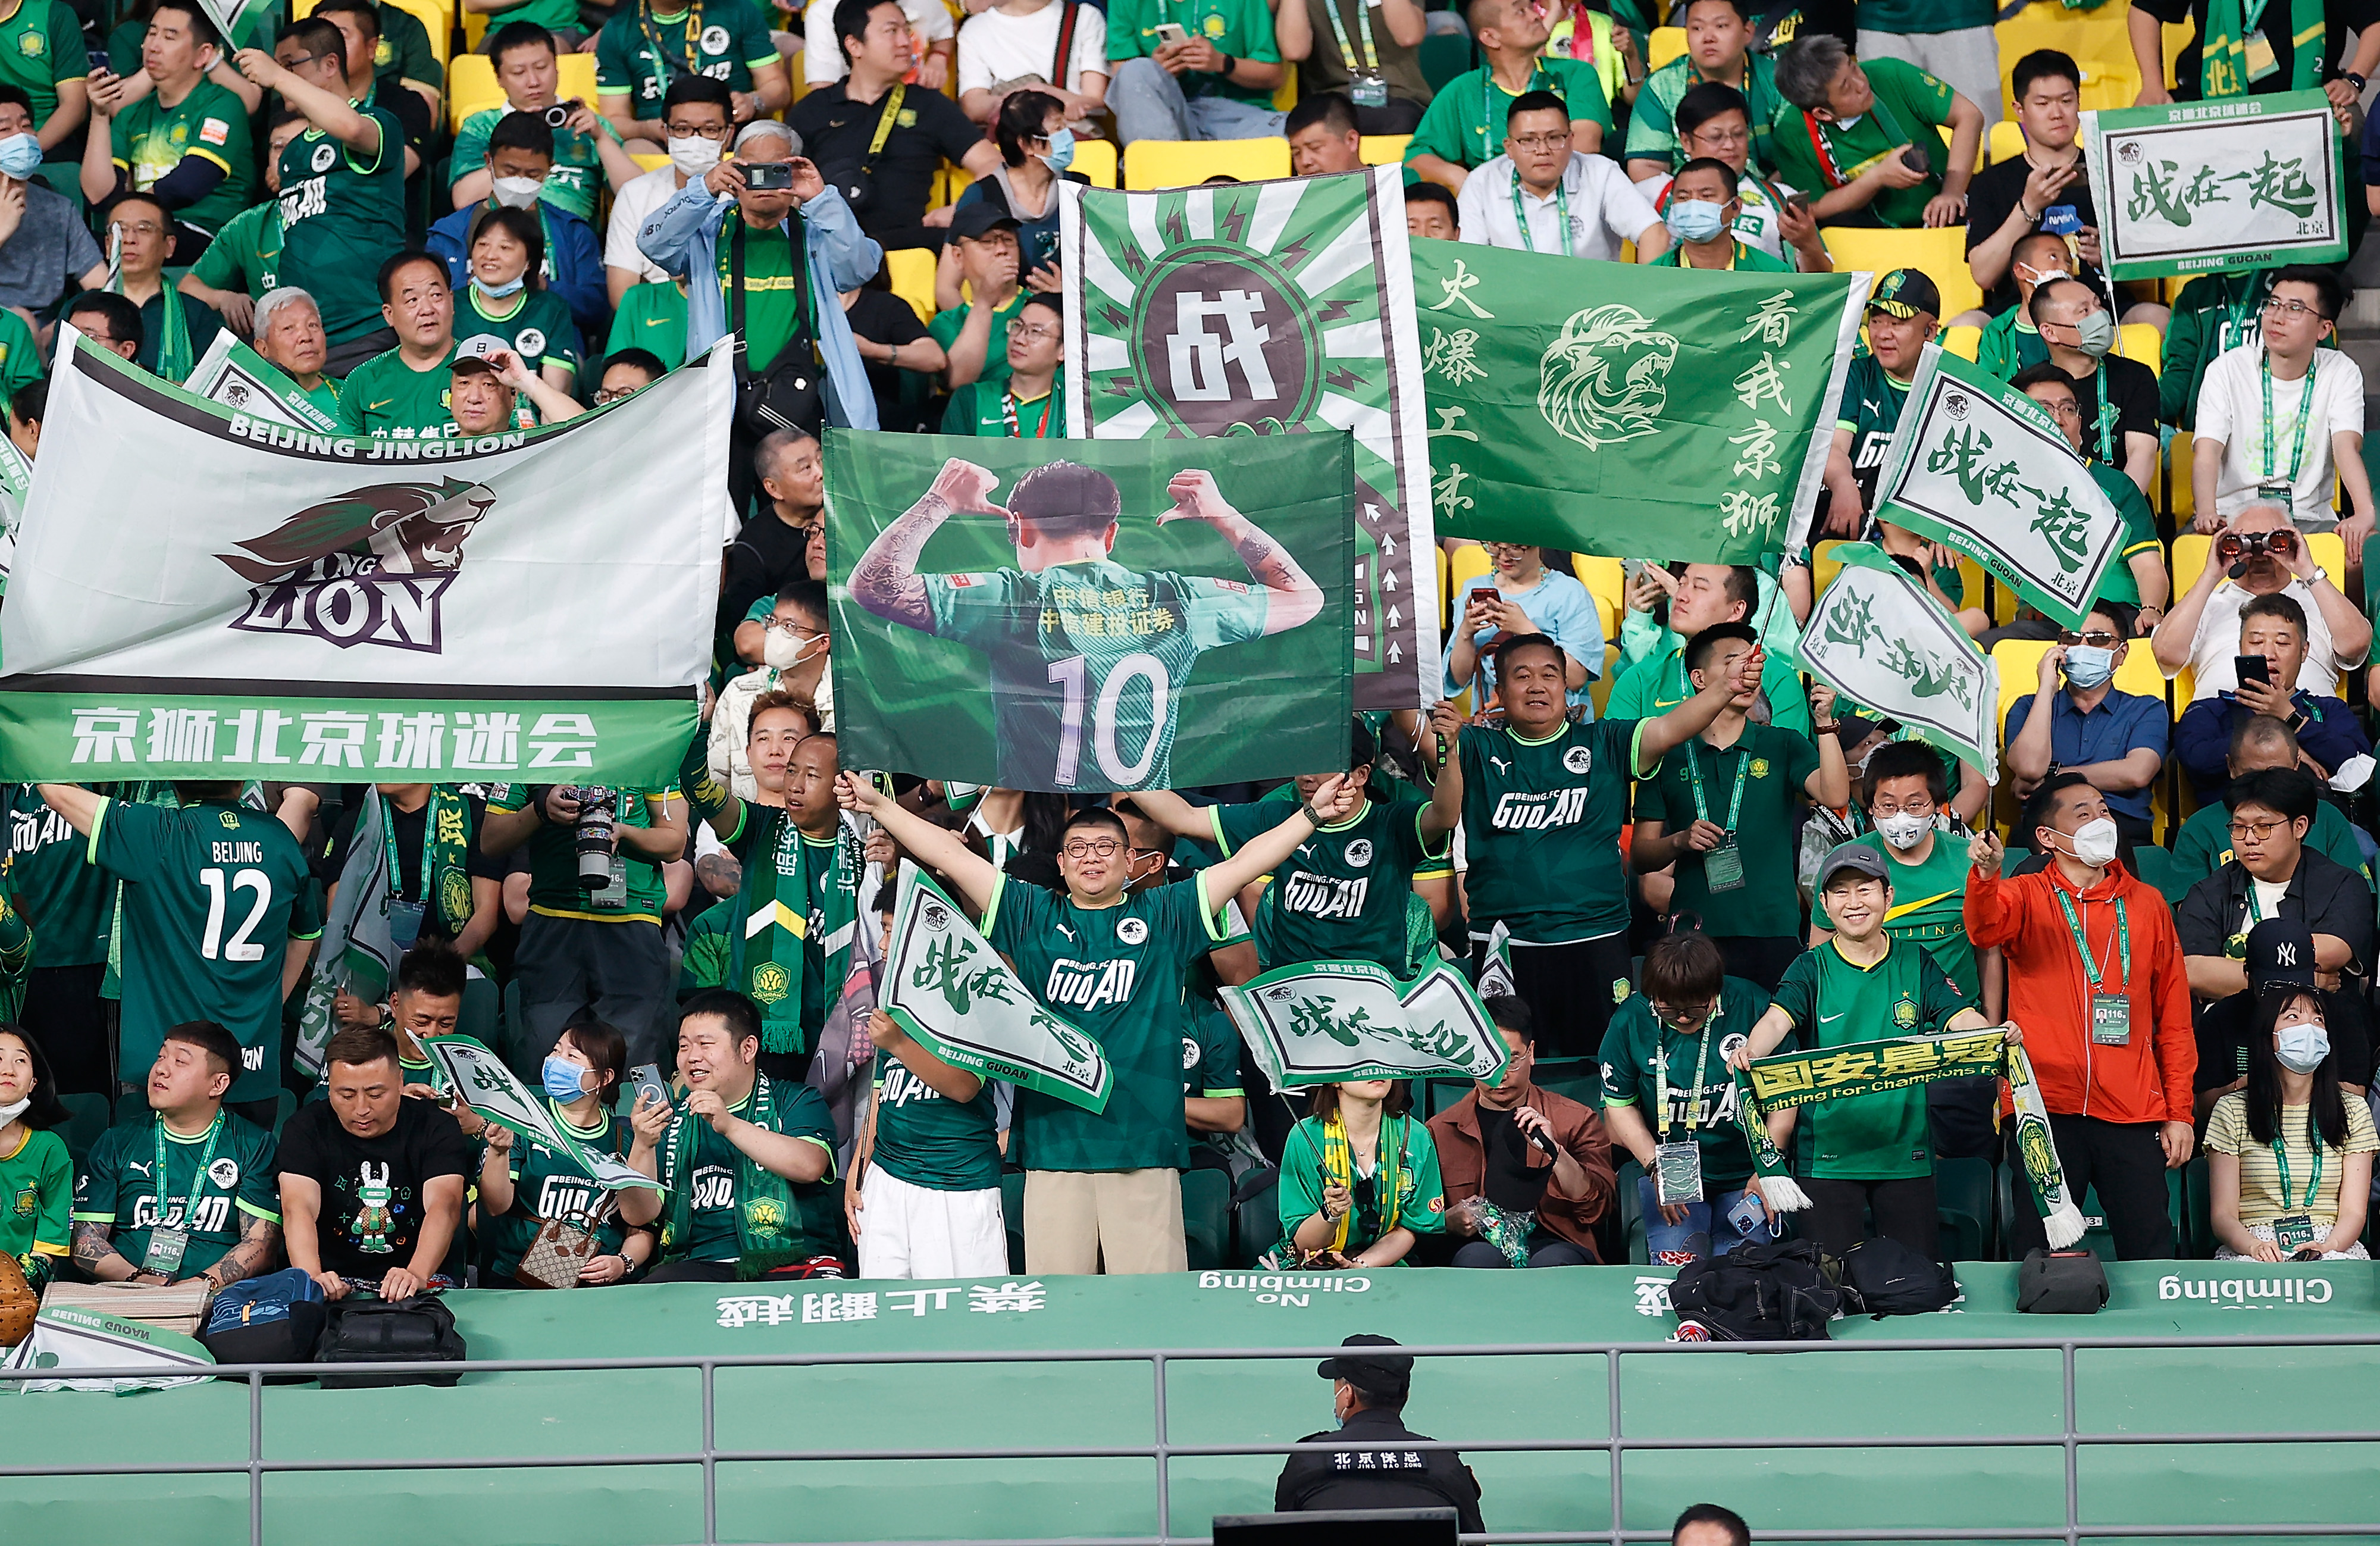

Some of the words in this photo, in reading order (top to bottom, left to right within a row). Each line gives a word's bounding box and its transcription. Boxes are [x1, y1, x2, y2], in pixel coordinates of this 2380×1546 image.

[2127, 149, 2319, 227] 战在一起
[2297, 221, 2325, 236] 北京
[2177, 257, 2224, 271] BEIJING
[2227, 254, 2272, 265] GUOAN
[1721, 289, 1799, 544] 看我京狮
[228, 413, 355, 458] BEIJING
[367, 433, 526, 460] JINGLION
[1927, 423, 2092, 574] 战在一起
[1947, 531, 1989, 562] BEIJING
[1990, 558, 2023, 588] GUOAN
[1053, 586, 1150, 608] 中信银行
[2051, 572, 2079, 596] 北京
[242, 577, 446, 646] LION
[1040, 608, 1175, 637] 中信建投证券
[1048, 653, 1169, 787] 10
[71, 707, 597, 769] 京狮北京球迷会
[212, 841, 262, 863] BEIJING
[200, 868, 271, 961] 12
[2278, 942, 2296, 966] NY
[937, 1046, 984, 1068] BEIJING
[986, 1060, 1029, 1081] GUOAN
[1062, 1060, 1092, 1082] 北京
[1352, 1068, 1402, 1078] BEIJING
[1832, 1084, 1868, 1099] For
[1872, 1066, 1977, 1094] Champions
[1198, 1271, 1371, 1292] Climbing
[2158, 1277, 2334, 1304] Climbing
[716, 1281, 1047, 1329] 禁止翻越
[1255, 1293, 1310, 1307] No
